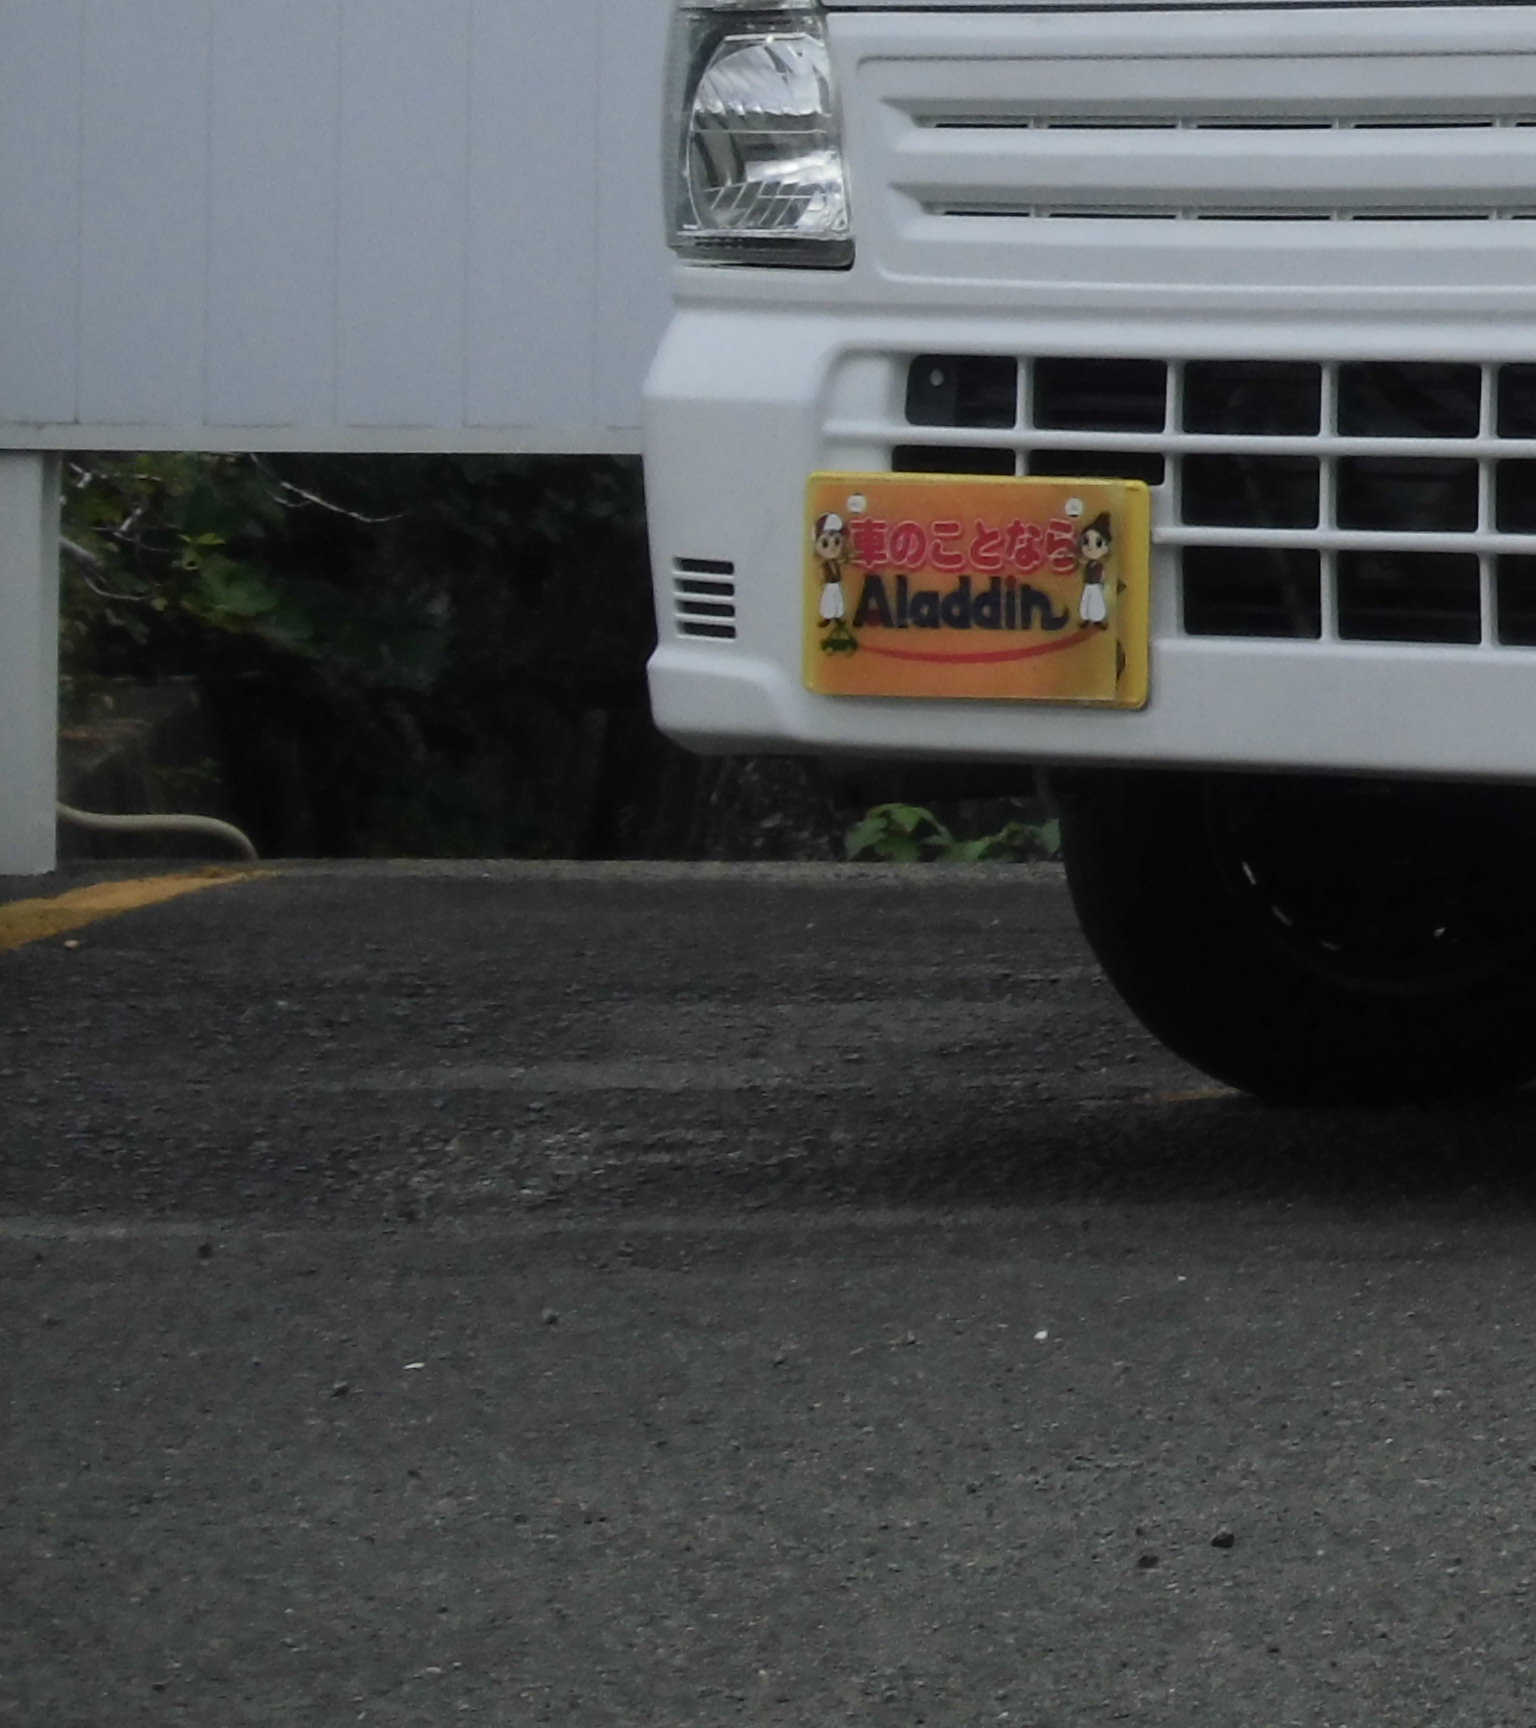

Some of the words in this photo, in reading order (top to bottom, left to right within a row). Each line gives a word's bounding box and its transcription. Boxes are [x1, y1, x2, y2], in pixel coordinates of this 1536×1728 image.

[849, 517, 1077, 571] 車のことなら
[852, 574, 1069, 631] Aladdin
